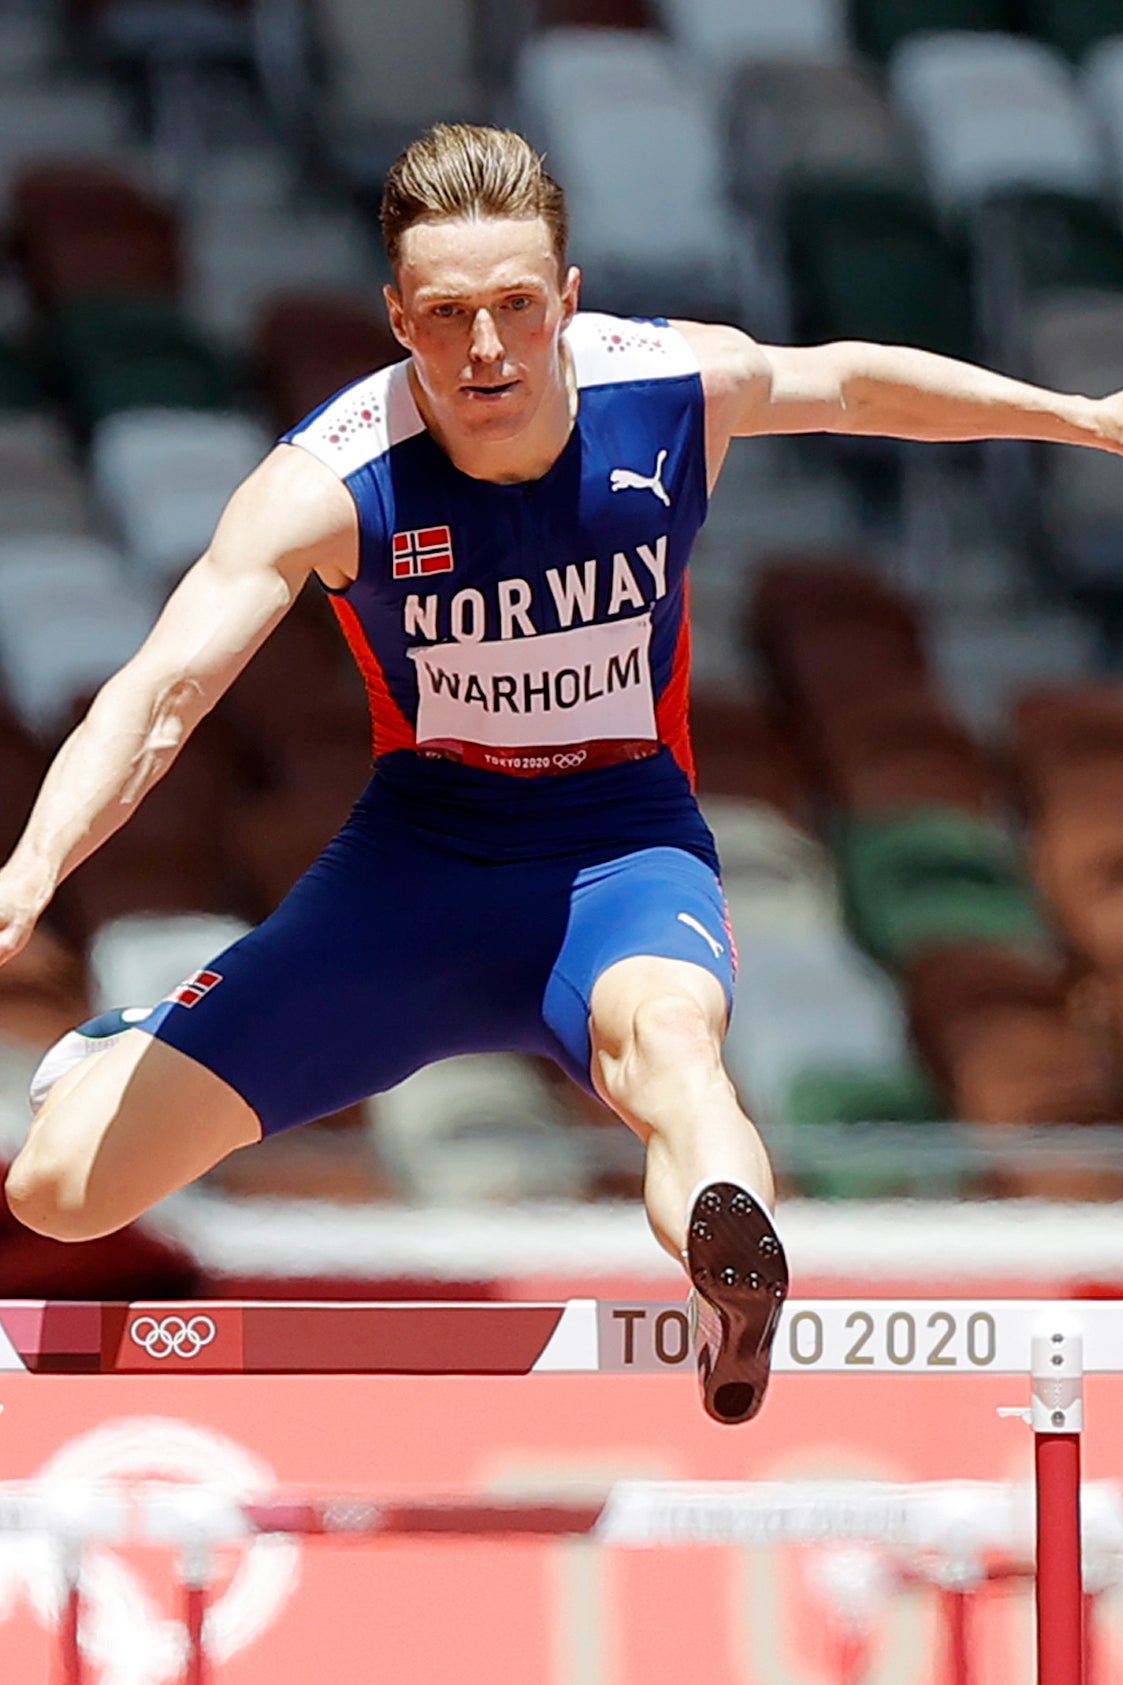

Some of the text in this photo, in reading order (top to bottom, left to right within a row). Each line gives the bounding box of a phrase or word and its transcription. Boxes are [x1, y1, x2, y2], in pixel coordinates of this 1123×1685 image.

[404, 535, 667, 643] NORWAY
[424, 647, 641, 713] WARHOLM
[484, 753, 550, 769] TOKYO 2020
[612, 1309, 996, 1366] TOO 2020
